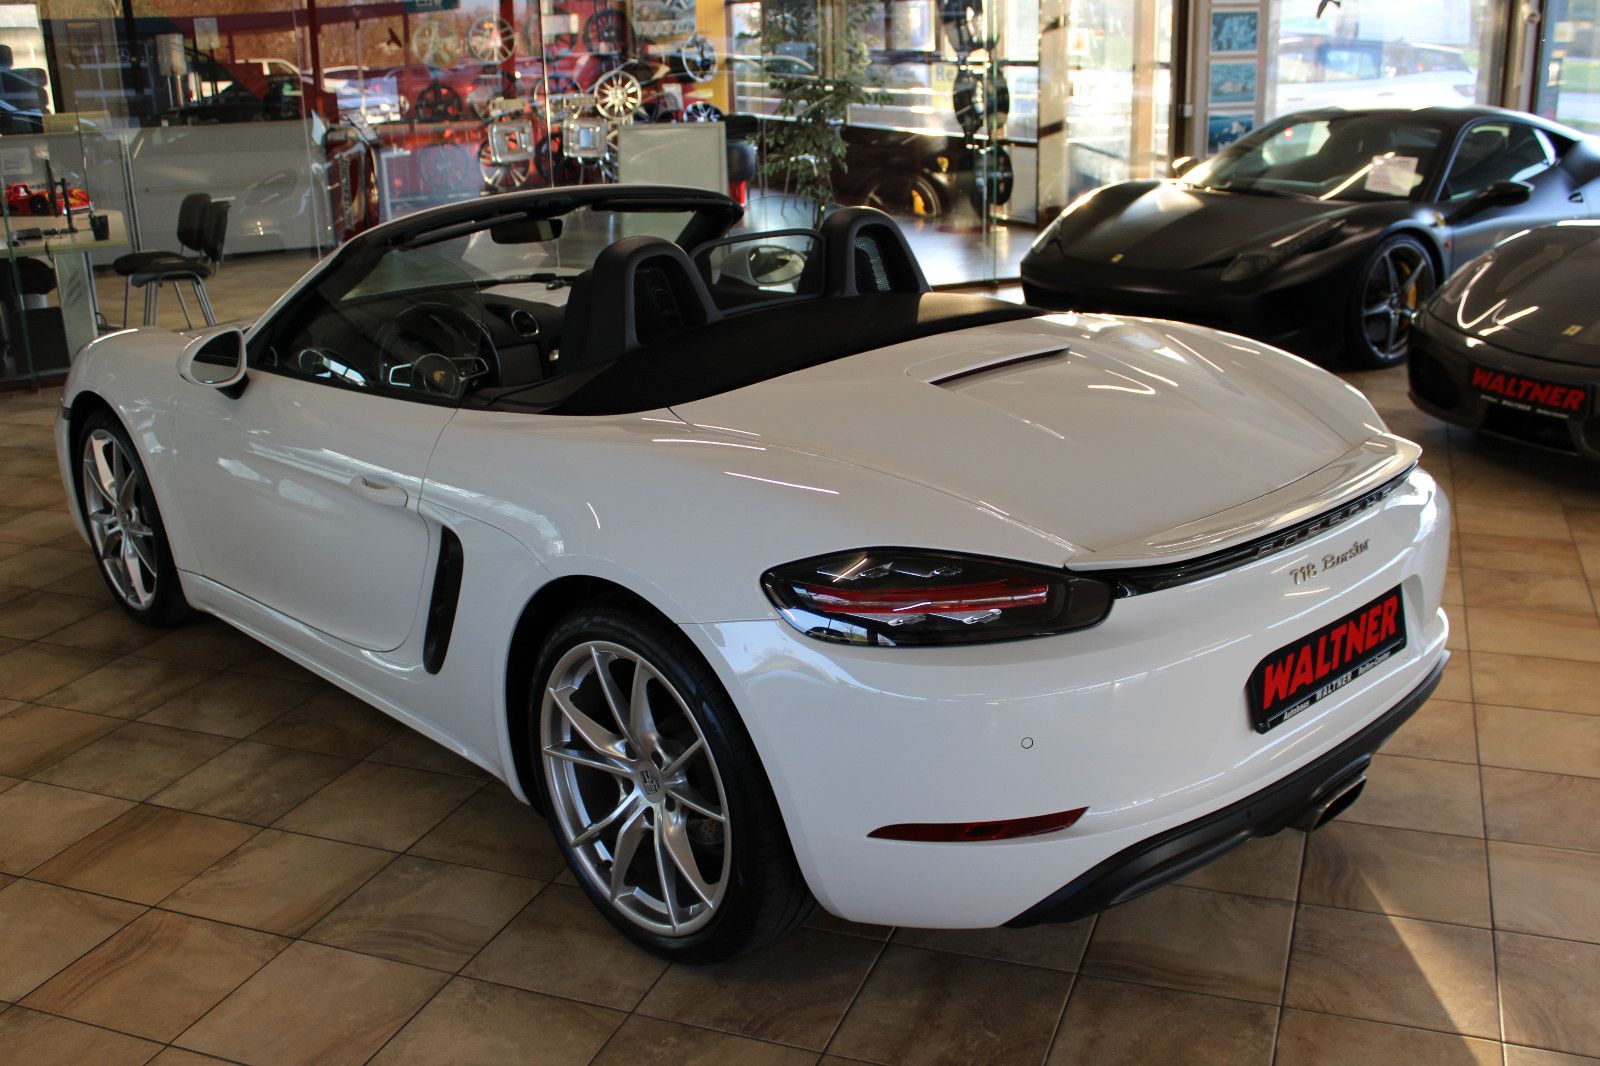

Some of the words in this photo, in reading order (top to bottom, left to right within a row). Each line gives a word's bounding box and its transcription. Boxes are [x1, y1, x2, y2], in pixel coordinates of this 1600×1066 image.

[1472, 367, 1585, 411] WALTNER
[1289, 563, 1319, 586] 718
[1263, 595, 1399, 710] WALTNER
[1315, 671, 1353, 701] WALTNER
